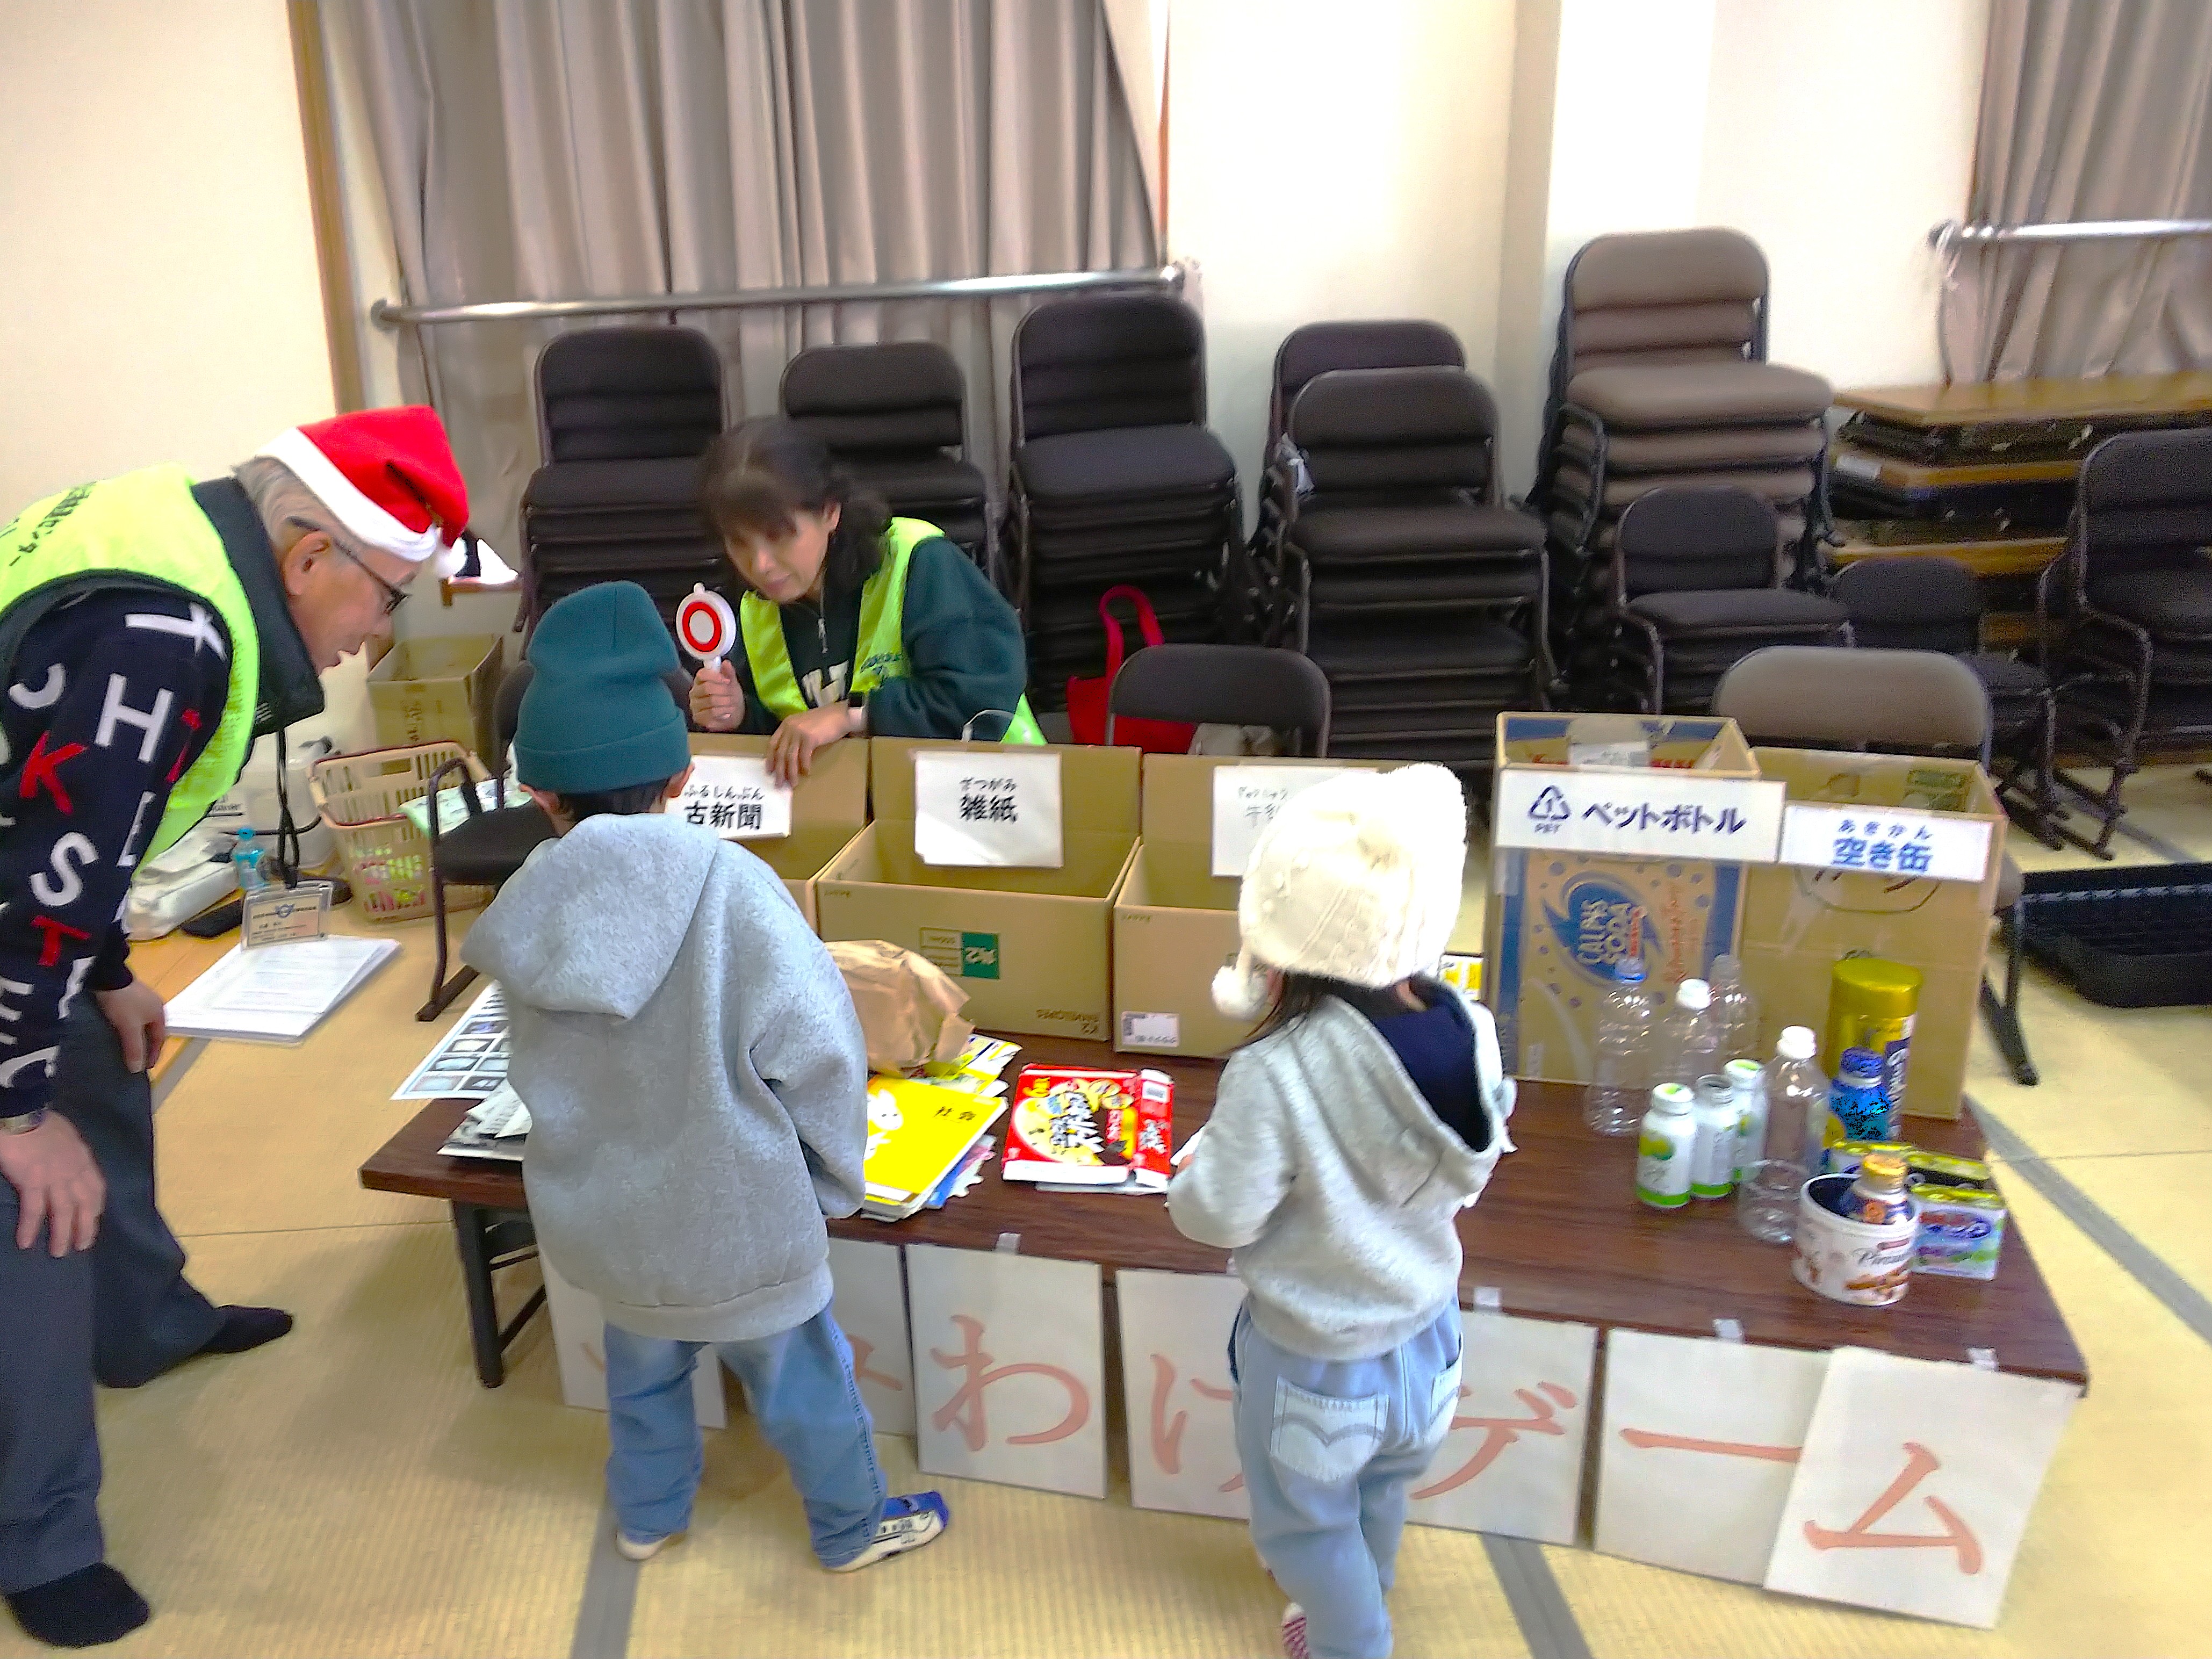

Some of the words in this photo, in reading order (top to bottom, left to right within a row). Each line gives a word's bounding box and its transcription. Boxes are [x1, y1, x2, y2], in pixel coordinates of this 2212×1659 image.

[94, 673, 174, 763] H
[19, 730, 89, 814] K
[684, 800, 762, 830] 古新聞
[960, 794, 1018, 823] 雑紙
[1581, 802, 1748, 835] ペットボトル
[1838, 818, 1933, 840] あきかん
[30, 832, 99, 907] S
[1832, 836, 1933, 872] 空き缶
